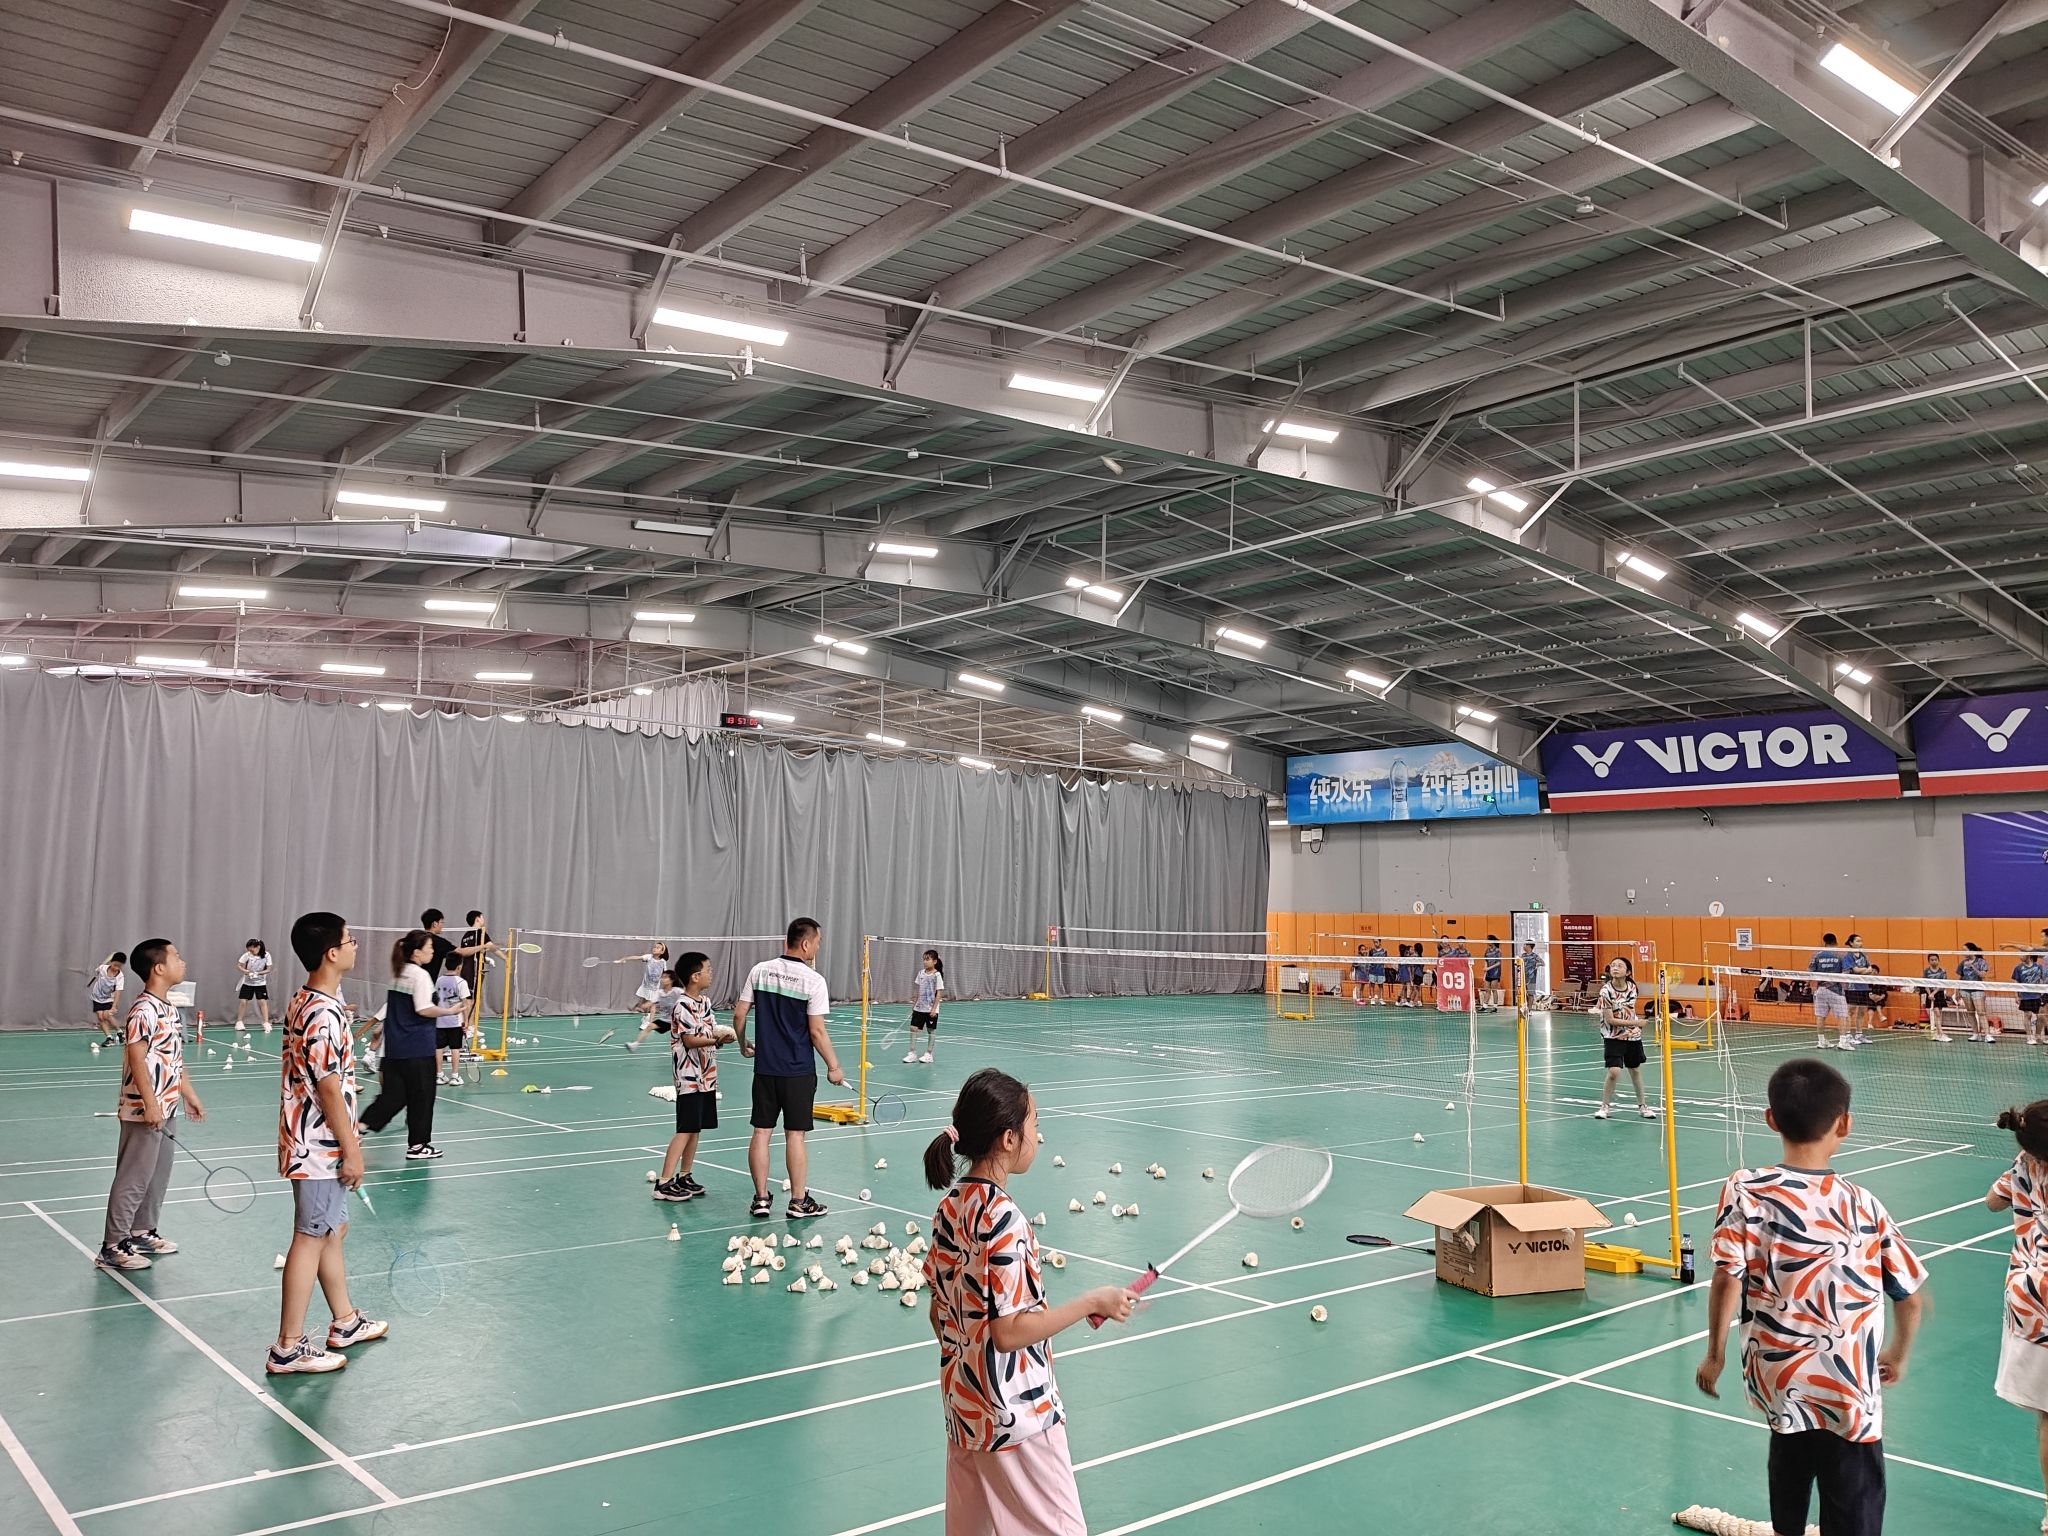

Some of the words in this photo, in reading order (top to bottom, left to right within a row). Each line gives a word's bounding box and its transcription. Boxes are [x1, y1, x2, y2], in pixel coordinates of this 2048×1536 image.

[1634, 723, 1851, 774] VICTOR
[1309, 777, 1372, 804] 纯水乐
[1421, 765, 1520, 796] 纯净由心
[1713, 903, 1720, 915] 7
[1639, 945, 1649, 954] 07
[1442, 971, 1466, 990] 03
